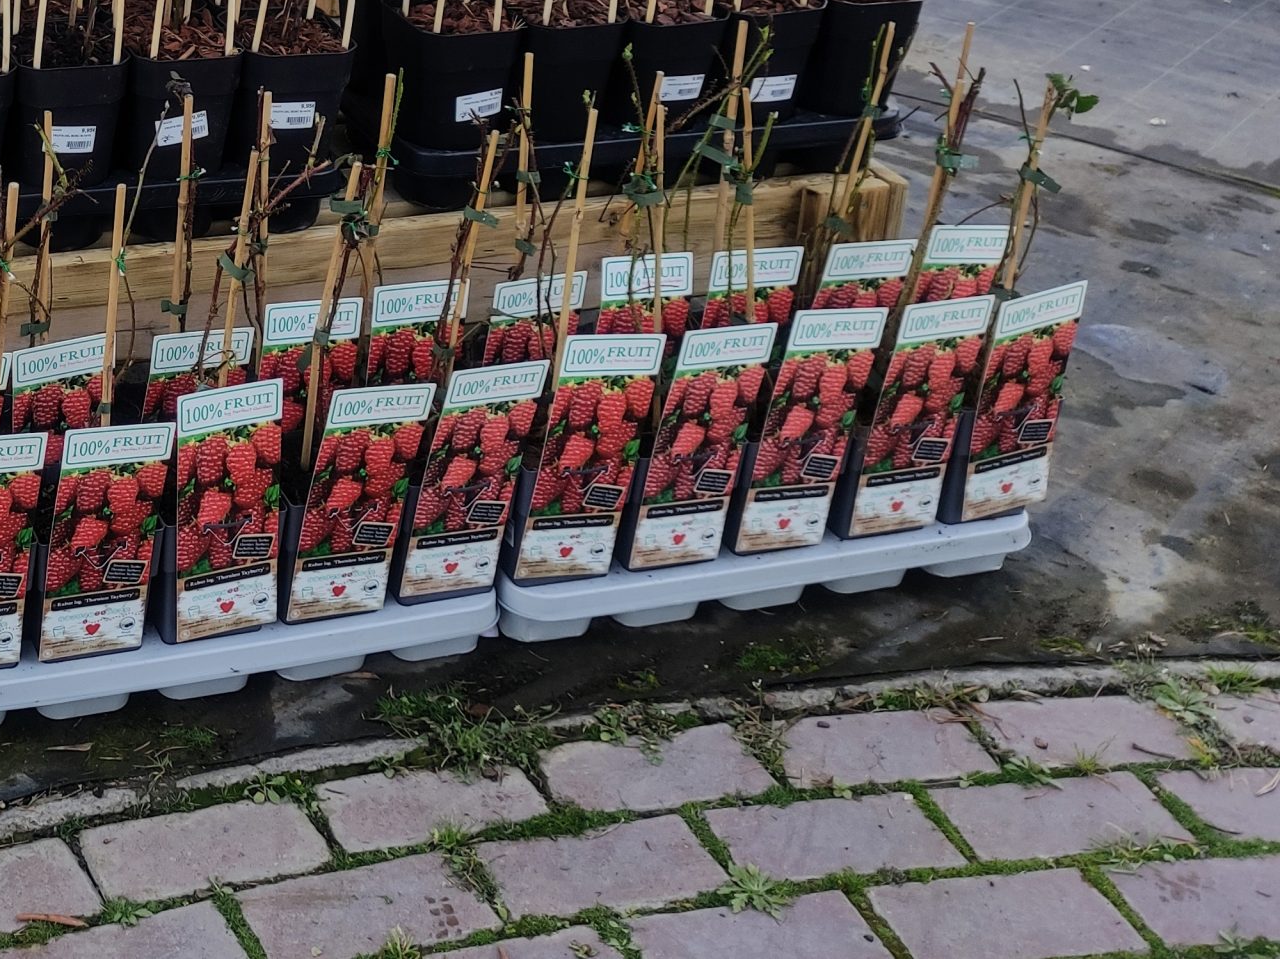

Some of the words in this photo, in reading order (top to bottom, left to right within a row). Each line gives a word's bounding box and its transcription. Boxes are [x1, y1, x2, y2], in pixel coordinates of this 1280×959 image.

[935, 238, 965, 252] 100%
[967, 236, 1007, 248] FRUIT
[834, 254, 864, 270] 100%
[867, 251, 907, 262] FRUIT
[380, 298, 414, 315] 100%
[501, 293, 534, 310] 100%
[1006, 307, 1037, 327] 100%
[1038, 292, 1080, 313] FRUIT
[271, 315, 306, 333] 100%
[908, 315, 942, 332] 100%
[943, 307, 985, 321] FRUIT
[799, 323, 832, 339] 100%
[834, 320, 878, 331] FRUIT
[160, 344, 194, 362] 100%
[570, 348, 604, 365] 100%
[608, 346, 655, 358] FRUIT
[688, 342, 722, 360] 100%
[724, 336, 768, 349] FRUIT
[22, 356, 58, 376] 100%
[456, 378, 490, 396] 100%
[492, 372, 539, 387] FRUIT
[186, 402, 222, 424] 100%
[224, 392, 274, 410] FRUIT
[338, 400, 372, 417] 100%
[375, 394, 425, 407] FRUIT
[72, 439, 110, 457] 100%
[112, 434, 164, 447] FRUIT
